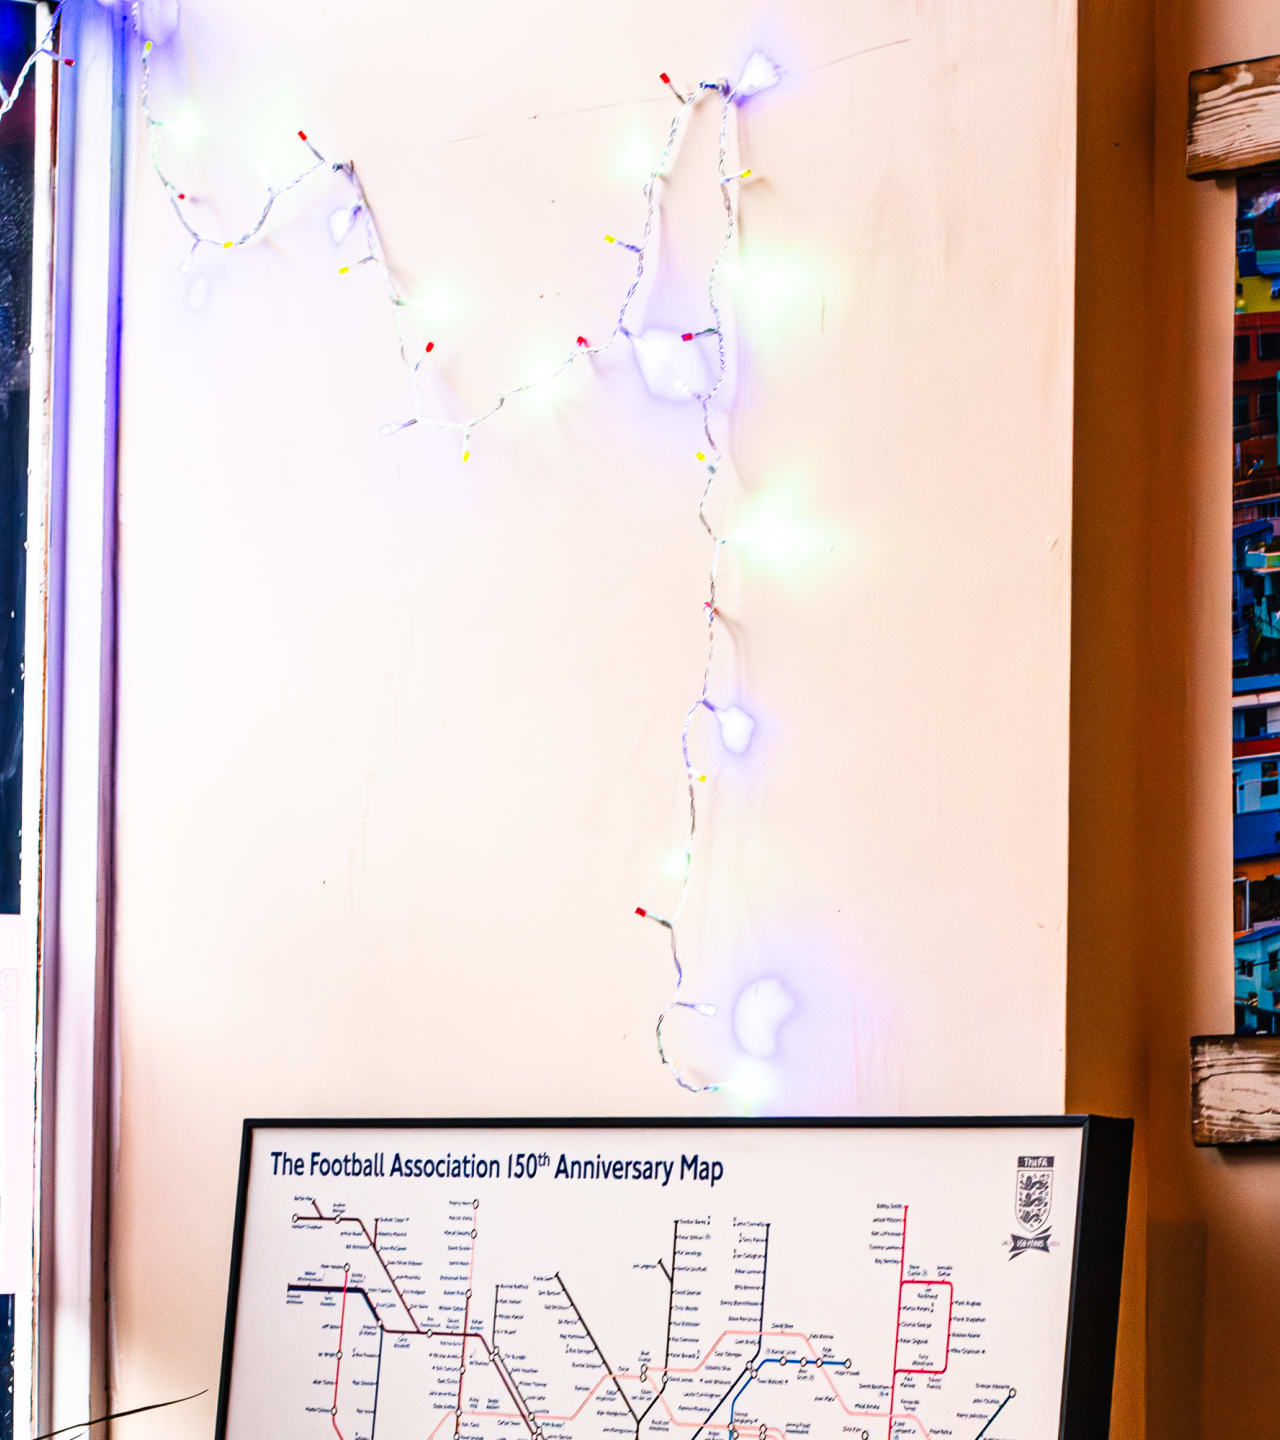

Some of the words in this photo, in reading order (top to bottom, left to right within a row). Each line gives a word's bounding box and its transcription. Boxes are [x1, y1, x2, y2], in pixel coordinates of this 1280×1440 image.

[270, 1152, 305, 1176] The
[310, 1152, 385, 1177] Football
[390, 1152, 501, 1179] Association
[554, 1153, 674, 1187] Anniversary
[680, 1154, 724, 1187] Map
